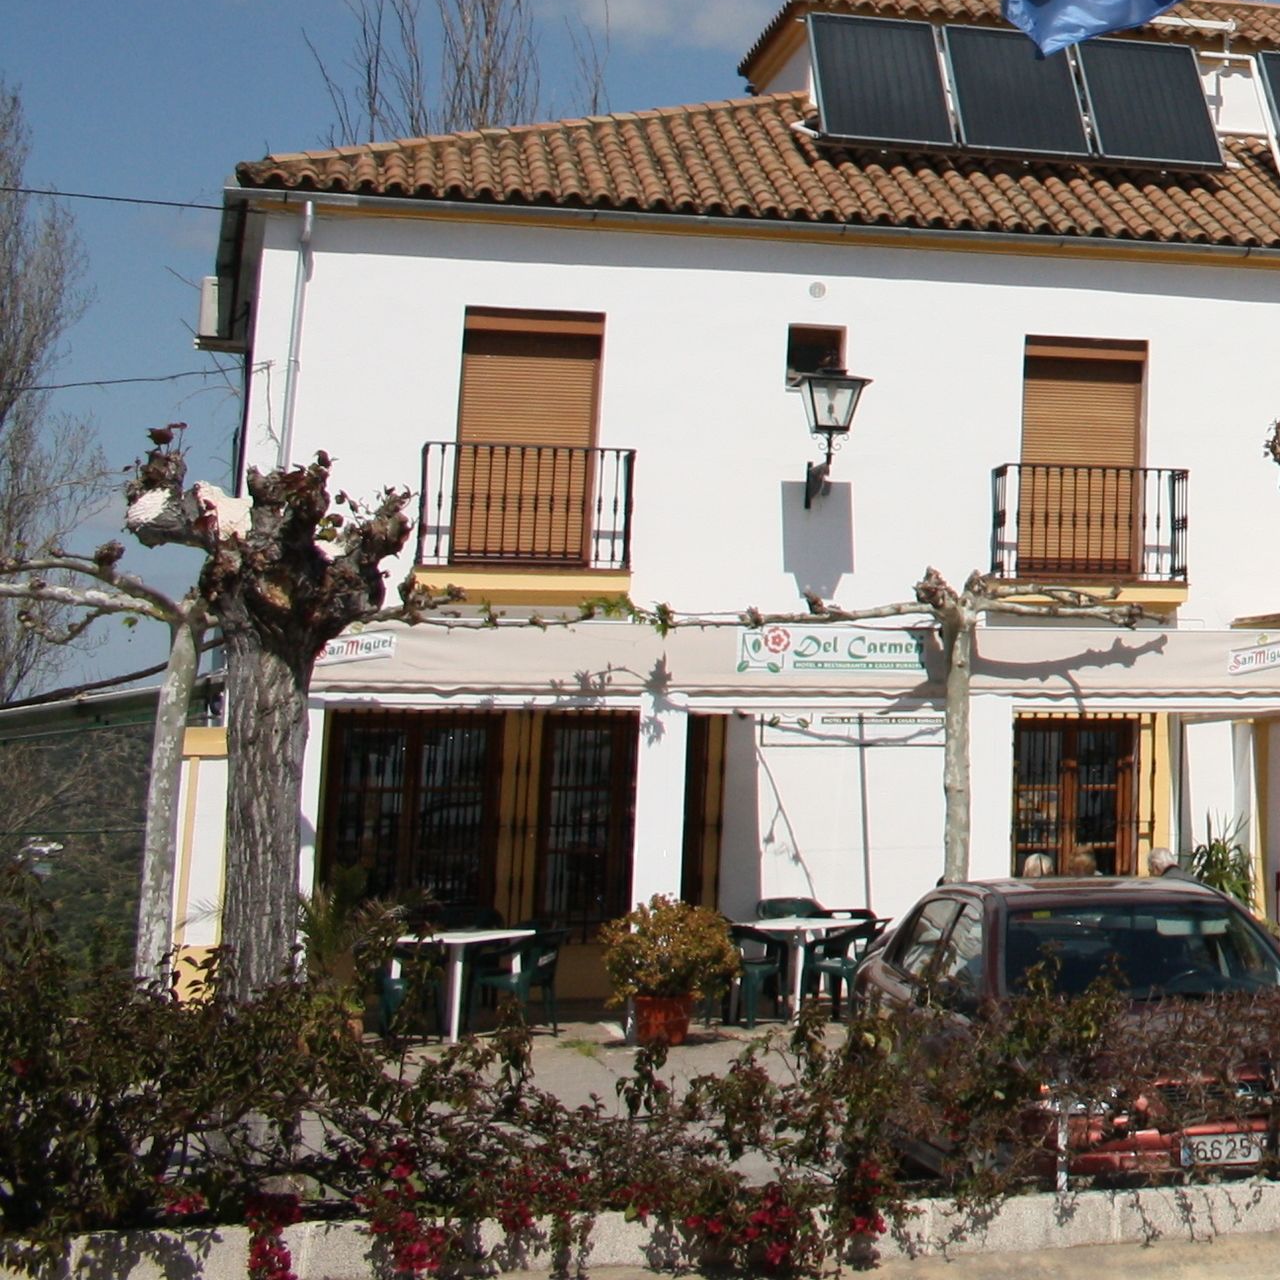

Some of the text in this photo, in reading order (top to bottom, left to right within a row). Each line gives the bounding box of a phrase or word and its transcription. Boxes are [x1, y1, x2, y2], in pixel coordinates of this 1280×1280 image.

[793, 635, 924, 659] Del Carmen
[1196, 1137, 1252, 1161] 6625
